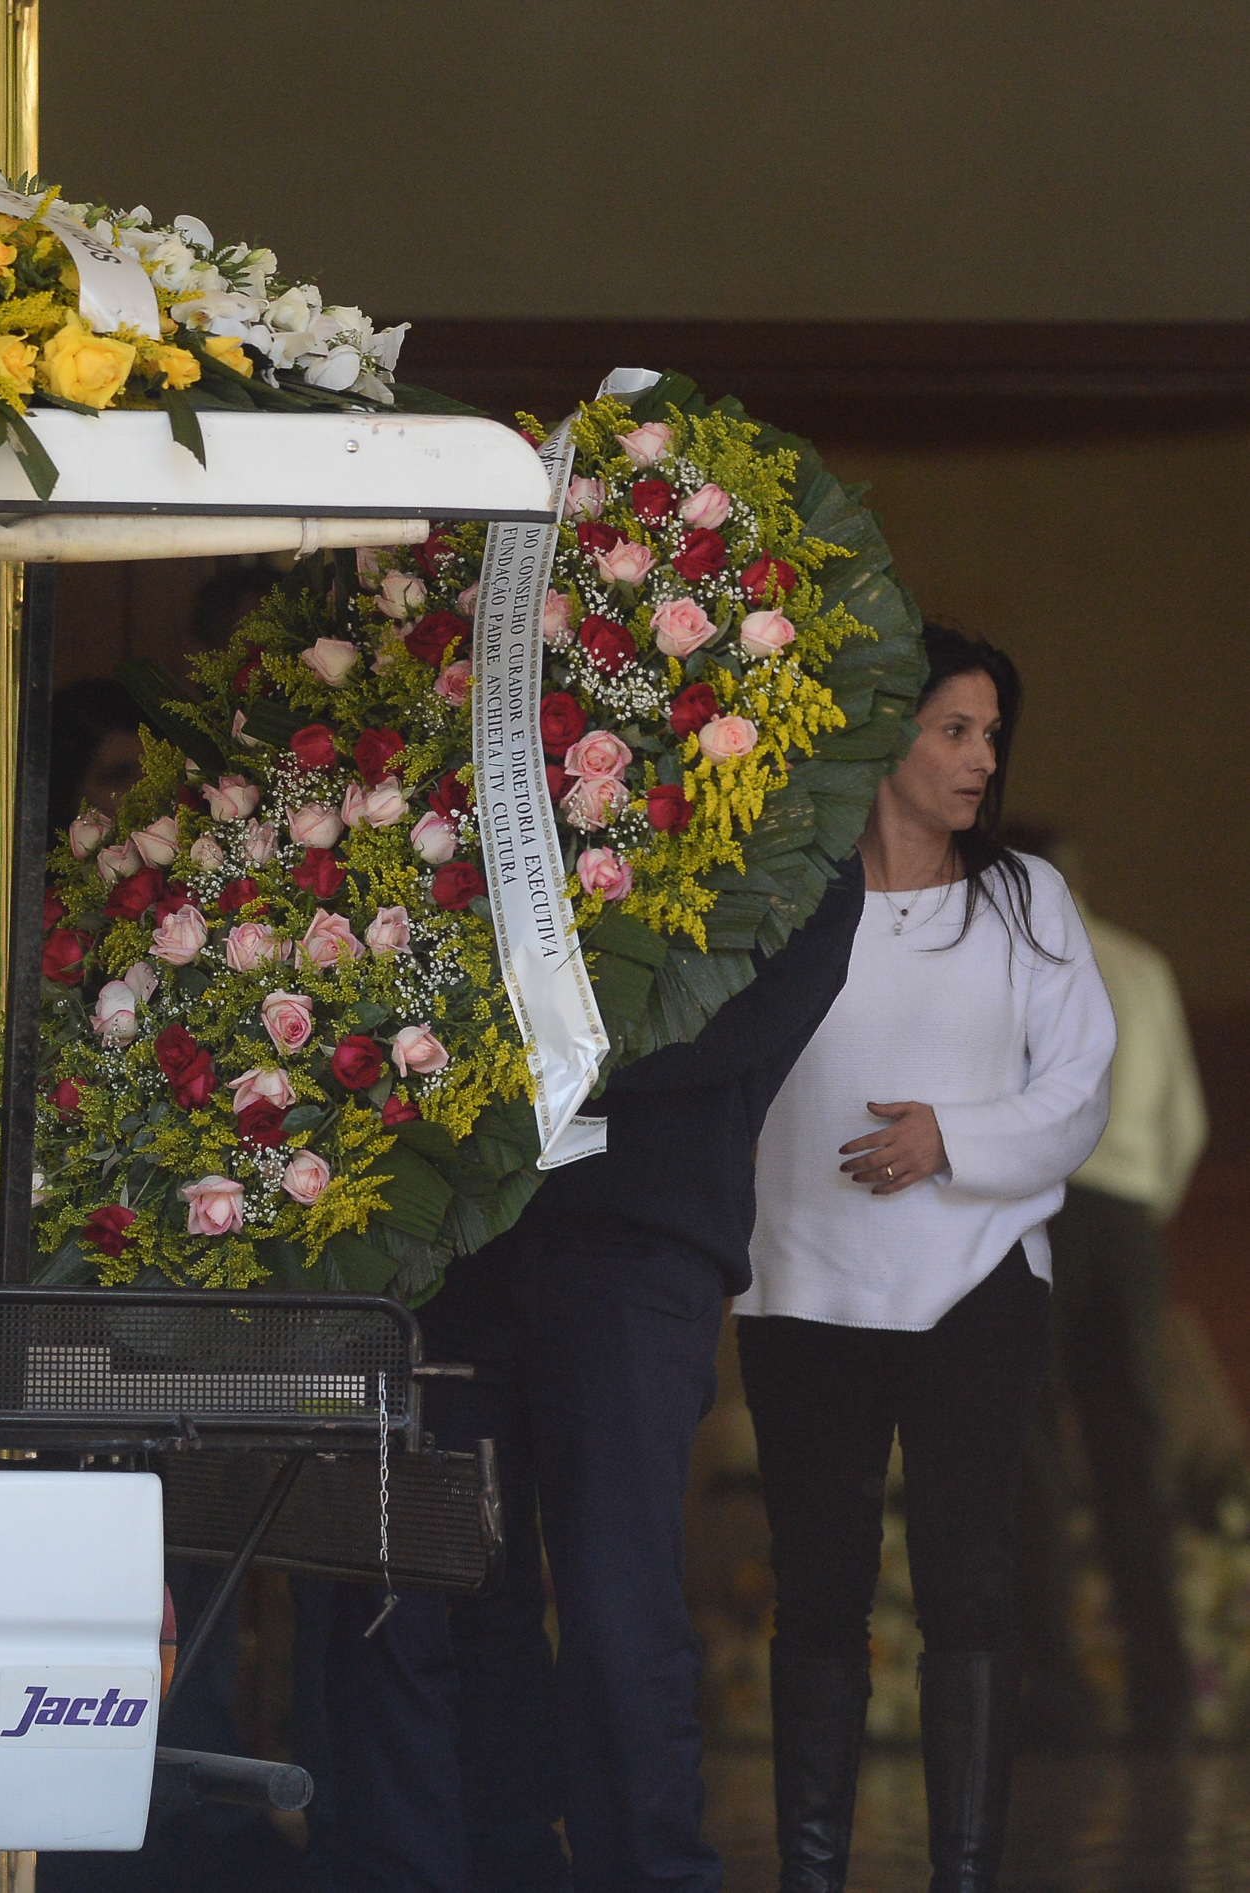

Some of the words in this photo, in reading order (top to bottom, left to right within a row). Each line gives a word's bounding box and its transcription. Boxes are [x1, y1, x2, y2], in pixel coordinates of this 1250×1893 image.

[490, 527, 518, 606] FUNDAÇÃO
[523, 528, 541, 549] DO
[510, 555, 536, 635] CONSELHO
[487, 613, 504, 666] PADRE
[508, 643, 525, 723] CURADOR
[511, 729, 525, 742] E
[511, 749, 537, 846] DIRETORIA
[492, 802, 518, 885] CULTURA
[524, 854, 559, 958] EXECUTIVA
[0, 1686, 149, 1737] Jacto
